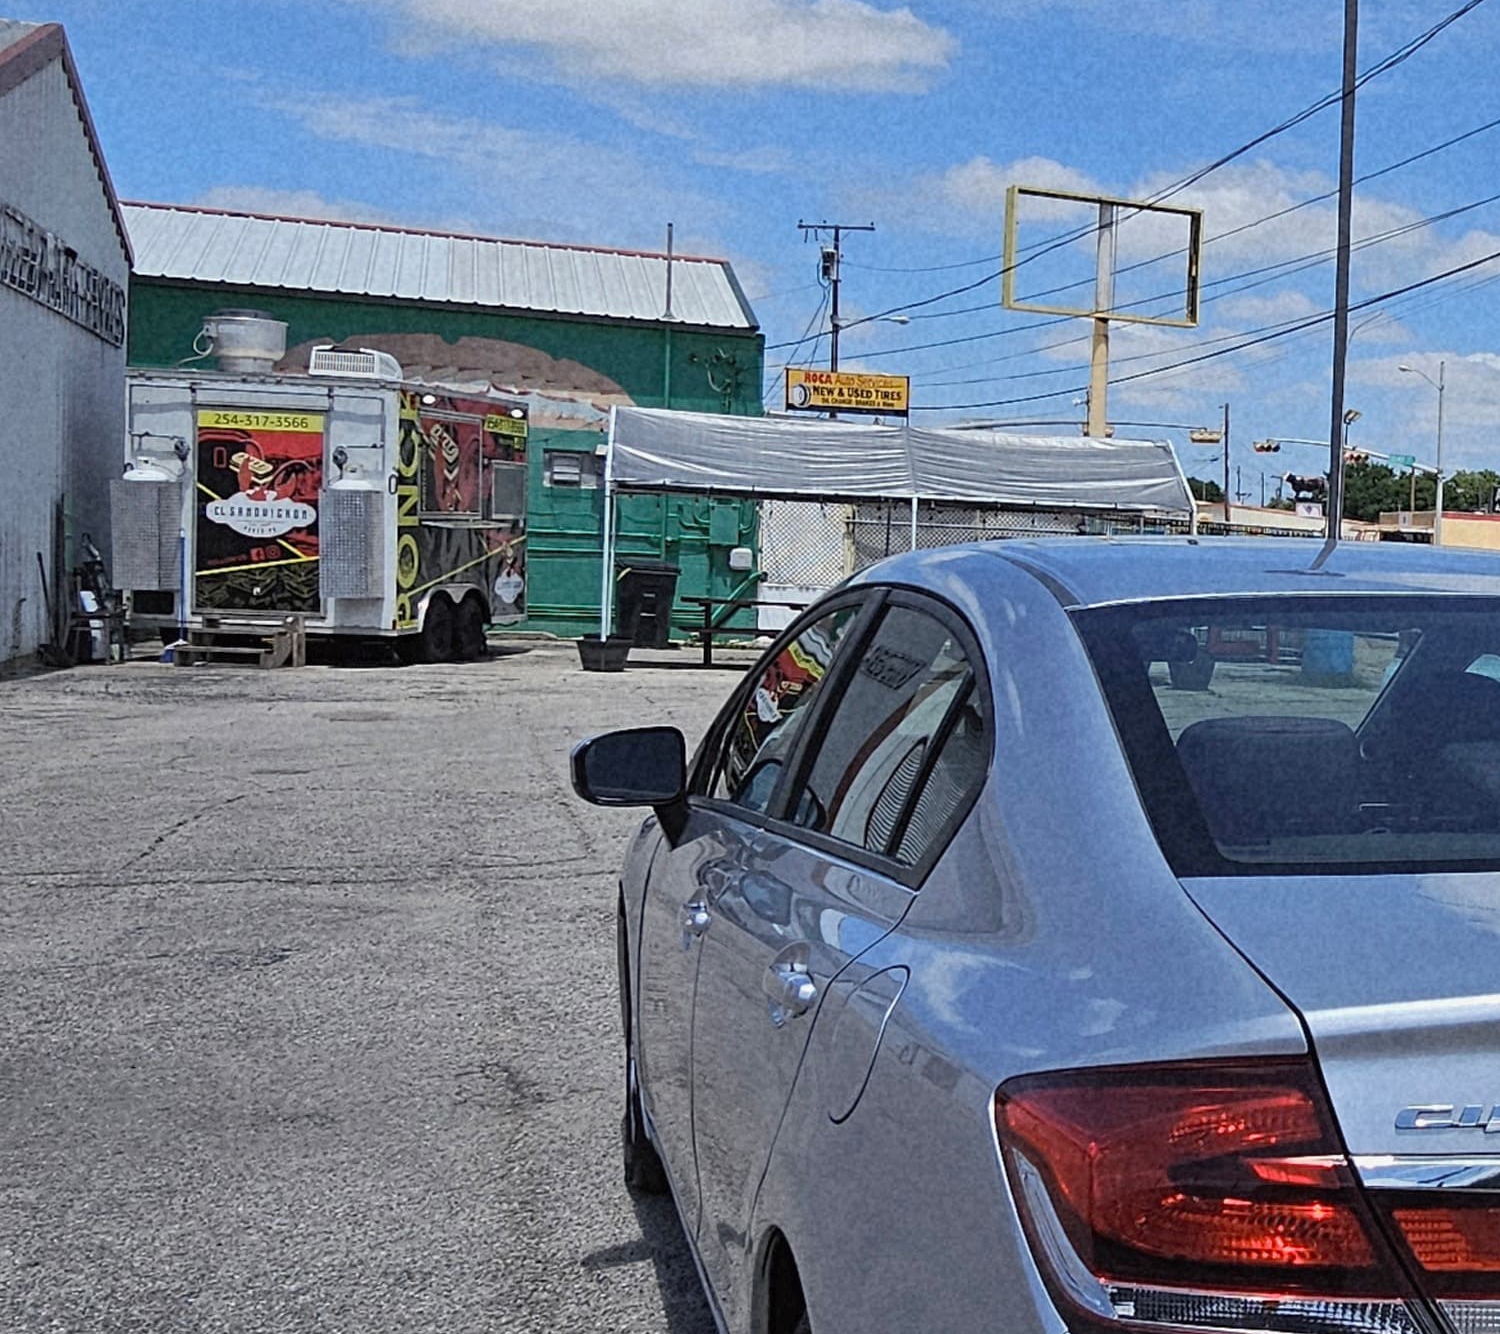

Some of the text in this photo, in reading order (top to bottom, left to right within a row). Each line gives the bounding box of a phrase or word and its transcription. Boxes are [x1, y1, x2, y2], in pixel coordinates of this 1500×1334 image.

[812, 385, 902, 401] NEW & USED TIRES
[214, 413, 309, 429] 254-317-3566
